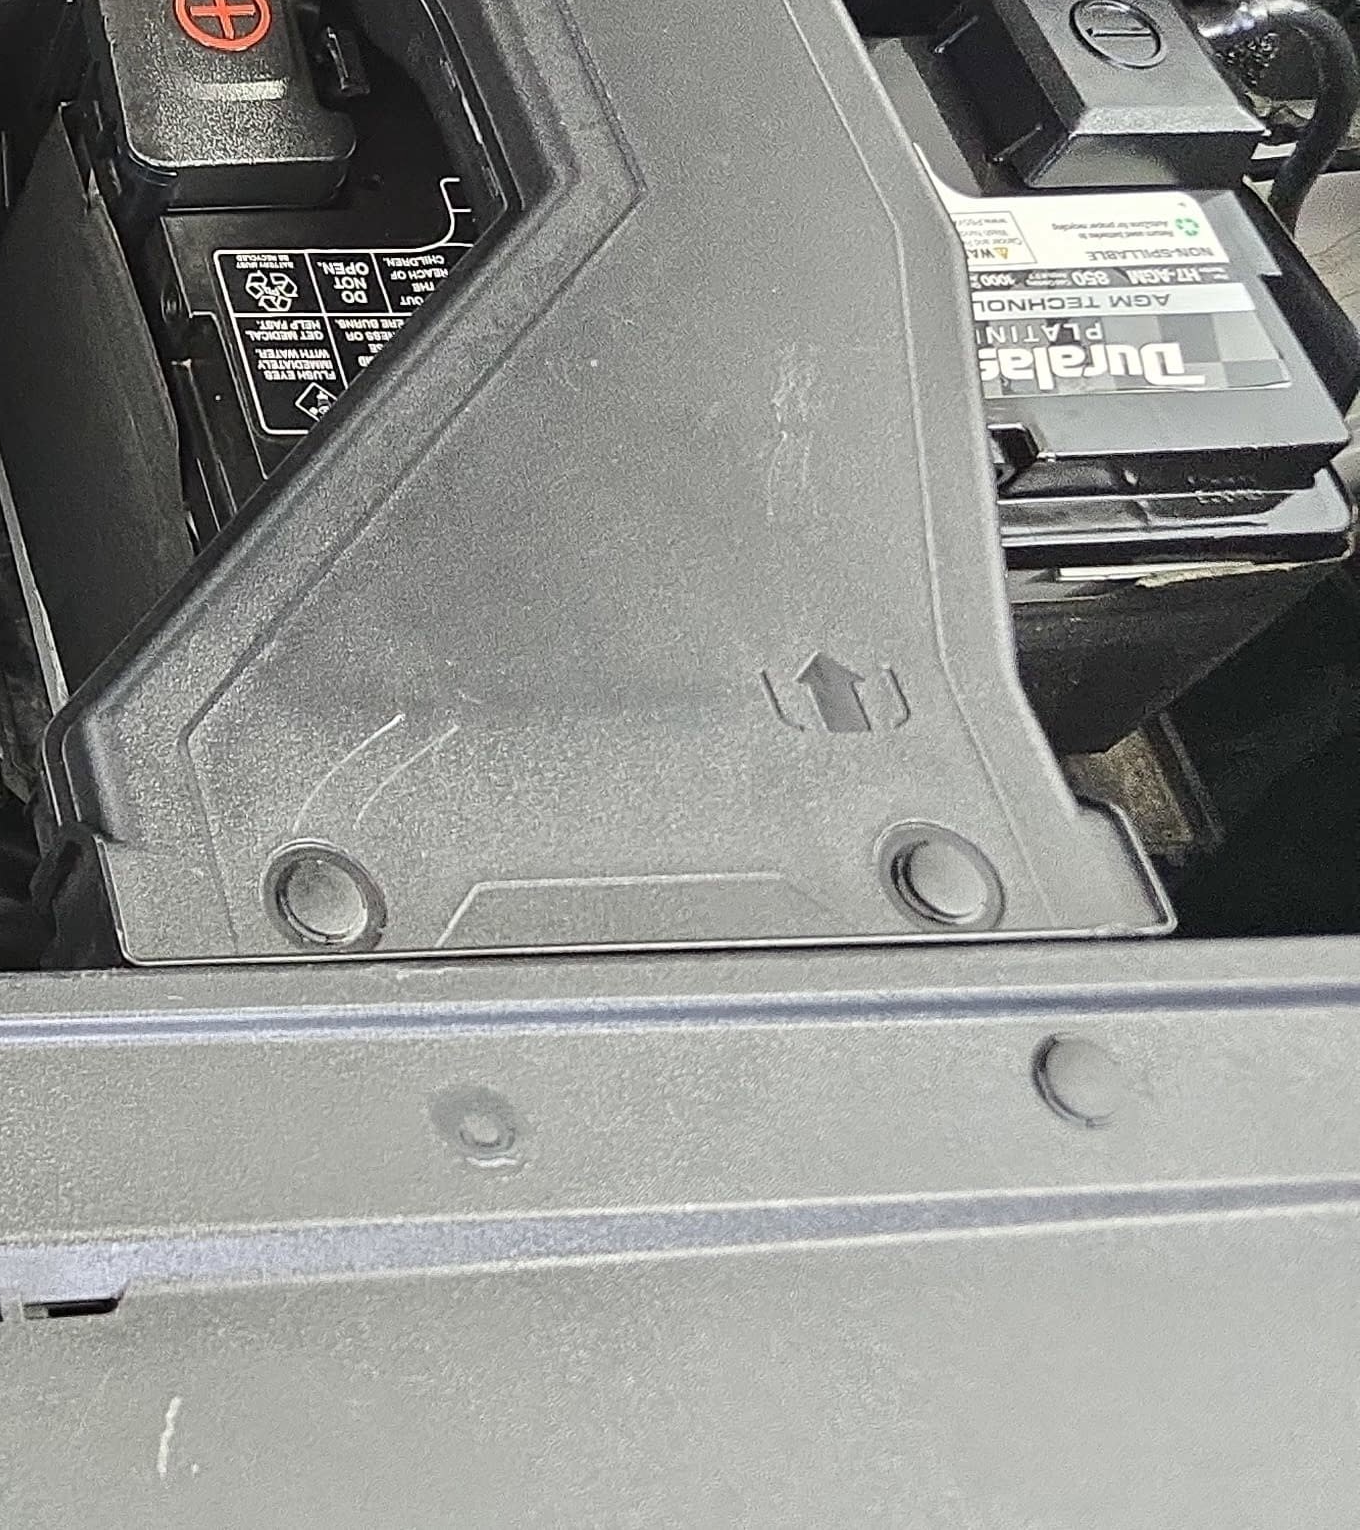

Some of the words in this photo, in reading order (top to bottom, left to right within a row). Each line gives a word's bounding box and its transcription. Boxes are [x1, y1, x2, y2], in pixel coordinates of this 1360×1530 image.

[1085, 247, 1215, 261] NON-SPILLABLE
[382, 255, 445, 268] CHILDREN.
[317, 261, 370, 275] OPEN.
[980, 273, 1017, 287] 1000
[1071, 270, 1110, 286] 850
[1127, 267, 1203, 285] H7-AGM
[334, 276, 367, 289] NOT
[341, 291, 368, 303] DO
[1109, 293, 1171, 308] AGM
[290, 319, 321, 330] HELP
[244, 330, 298, 341] MEDICAL
[300, 330, 324, 341] GET
[255, 348, 298, 359] WATER.
[299, 348, 331, 359] WITH
[257, 359, 333, 371] IMMEDIATELY
[264, 369, 295, 381] EYES
[296, 369, 336, 381] FLUSH
